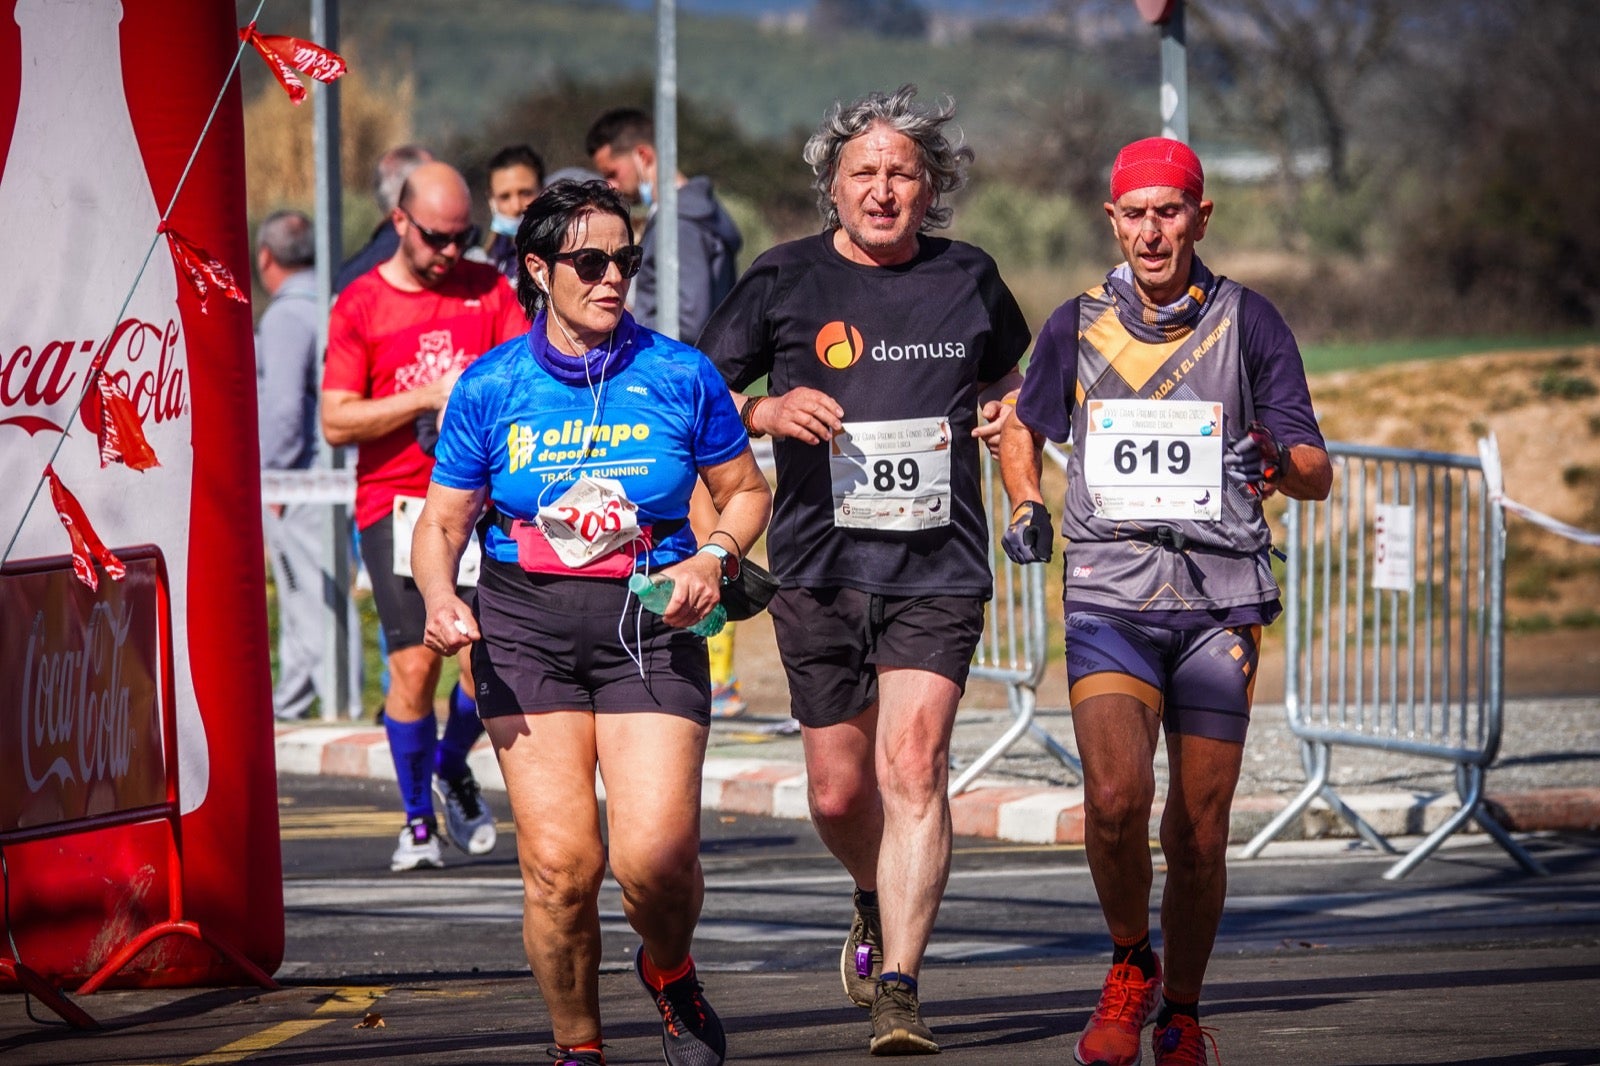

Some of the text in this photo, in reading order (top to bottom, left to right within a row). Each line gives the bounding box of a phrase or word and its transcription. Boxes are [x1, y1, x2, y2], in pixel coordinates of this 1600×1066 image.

[871, 340, 966, 362] domusa
[1173, 370, 1183, 382] X
[1181, 359, 1195, 375] EL
[1193, 317, 1232, 363] RUNNING
[0, 318, 185, 434] ca-Cola
[543, 419, 650, 447] olimpo
[538, 447, 607, 463] deportes
[1114, 439, 1191, 475] 619
[540, 465, 649, 483] TRAIL & RUNNING
[873, 458, 920, 492] 89
[558, 500, 621, 543] 206
[21, 600, 135, 794] Coca-Cola
